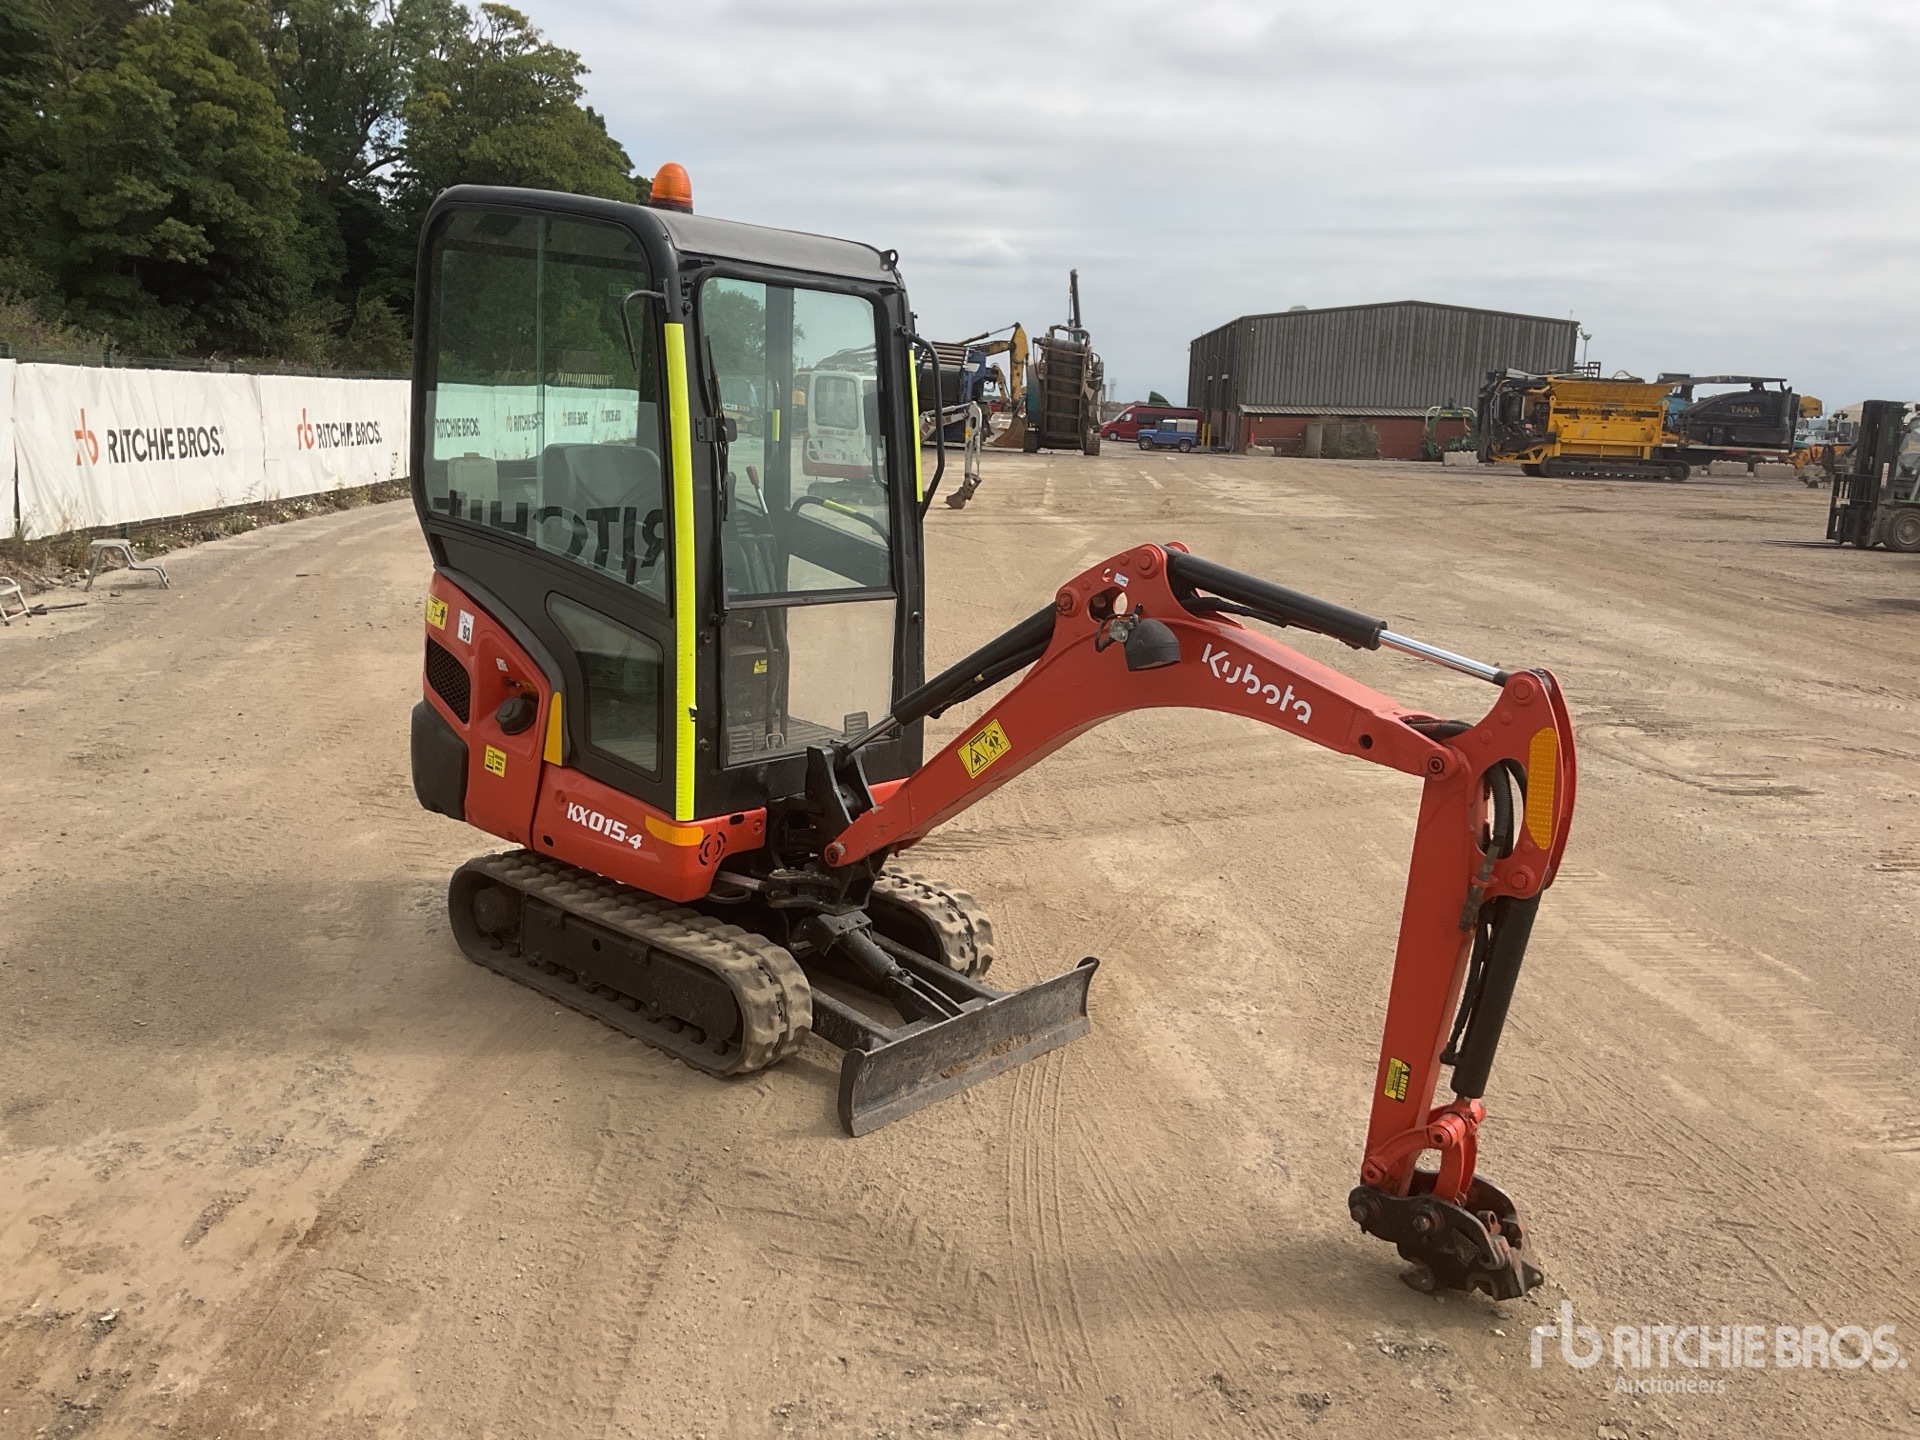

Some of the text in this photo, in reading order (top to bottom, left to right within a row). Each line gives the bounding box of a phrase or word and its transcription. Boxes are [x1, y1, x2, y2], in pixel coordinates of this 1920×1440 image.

[1730, 405, 1760, 414] TANA
[1795, 428, 1816, 436] QUICK
[107, 428, 175, 464] RITCHIE
[1202, 643, 1312, 724] Kubota
